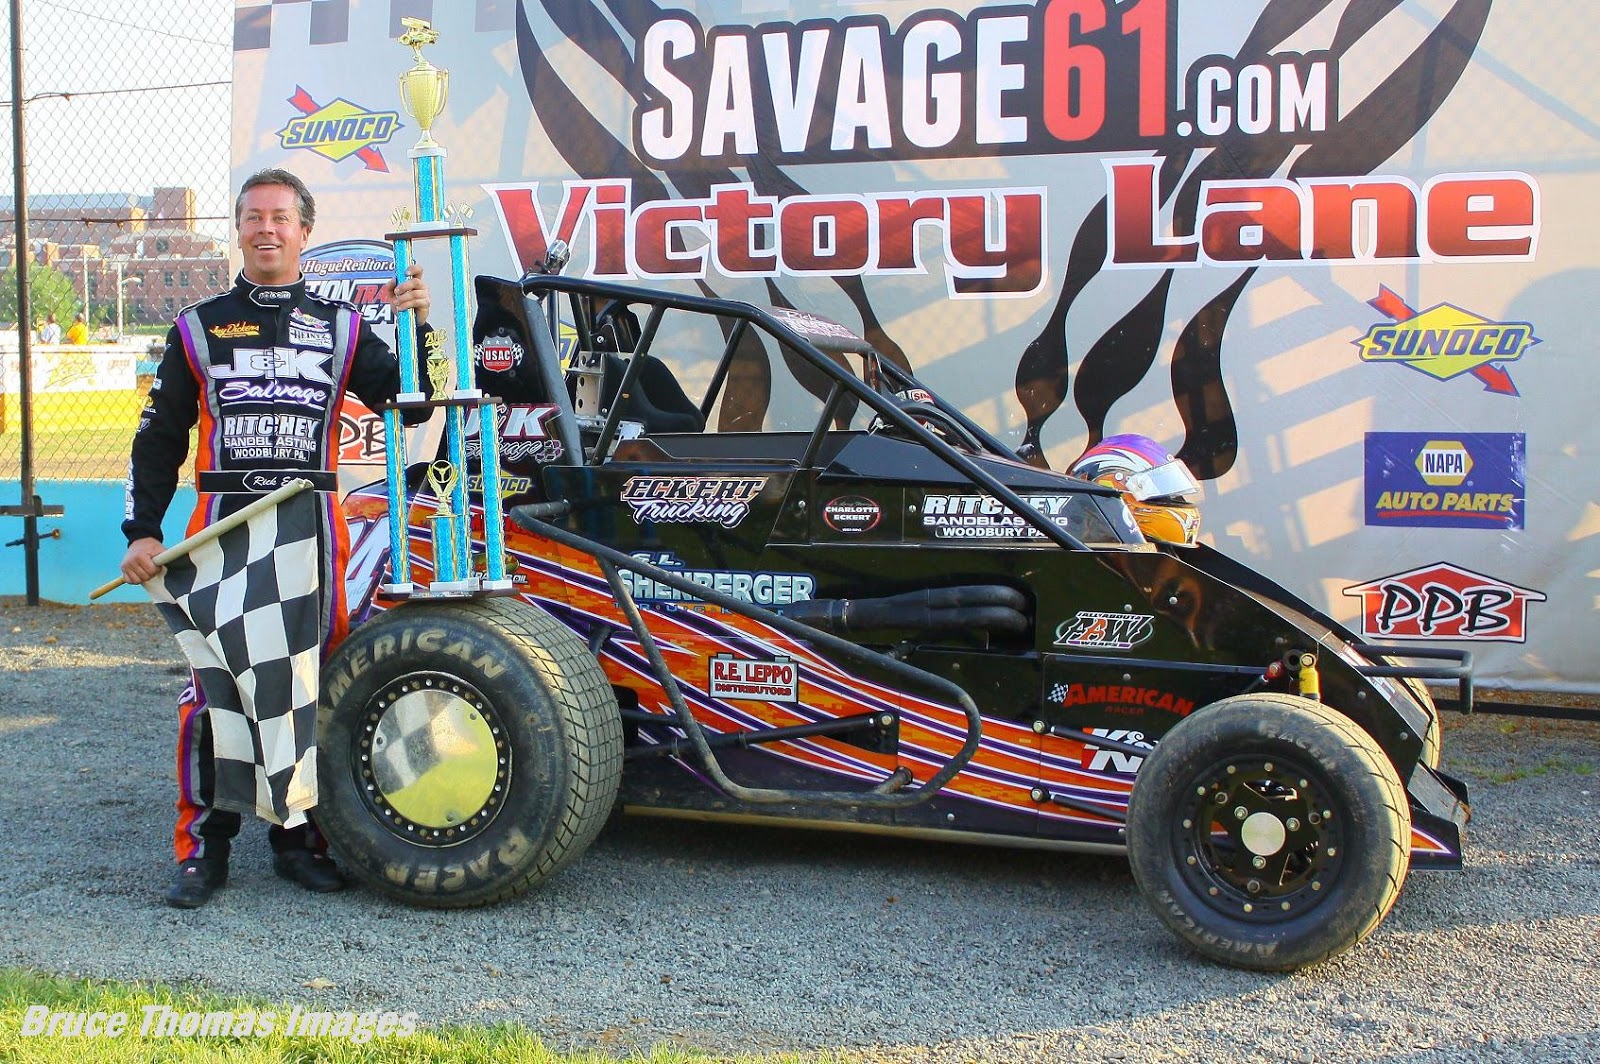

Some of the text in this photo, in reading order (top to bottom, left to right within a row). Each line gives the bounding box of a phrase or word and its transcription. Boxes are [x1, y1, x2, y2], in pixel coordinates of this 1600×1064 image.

[287, 116, 393, 144] SUNOCO
[481, 153, 1542, 300] Victory Lane
[353, 284, 390, 304] TRA
[1367, 328, 1526, 356] SUNOCO
[207, 346, 337, 386] J&K
[485, 350, 511, 361] USAC
[219, 379, 328, 404] Salvage
[222, 412, 322, 439] RITCHEY
[234, 446, 292, 459] WOODBURY
[1424, 454, 1464, 475] NAPA
[252, 475, 278, 487] Rick
[621, 476, 768, 501] ECKERT
[629, 498, 748, 528] Trucking
[1376, 491, 1515, 512] AUTO PARTS
[923, 516, 1068, 526] SANDBLASG
[942, 526, 1025, 538] WOODBURY
[1377, 580, 1516, 636] PPB
[714, 661, 793, 685] R.E. LEPPO
[714, 683, 792, 696] DISTRIBUTORS
[1063, 683, 1195, 717] AMERICAN
